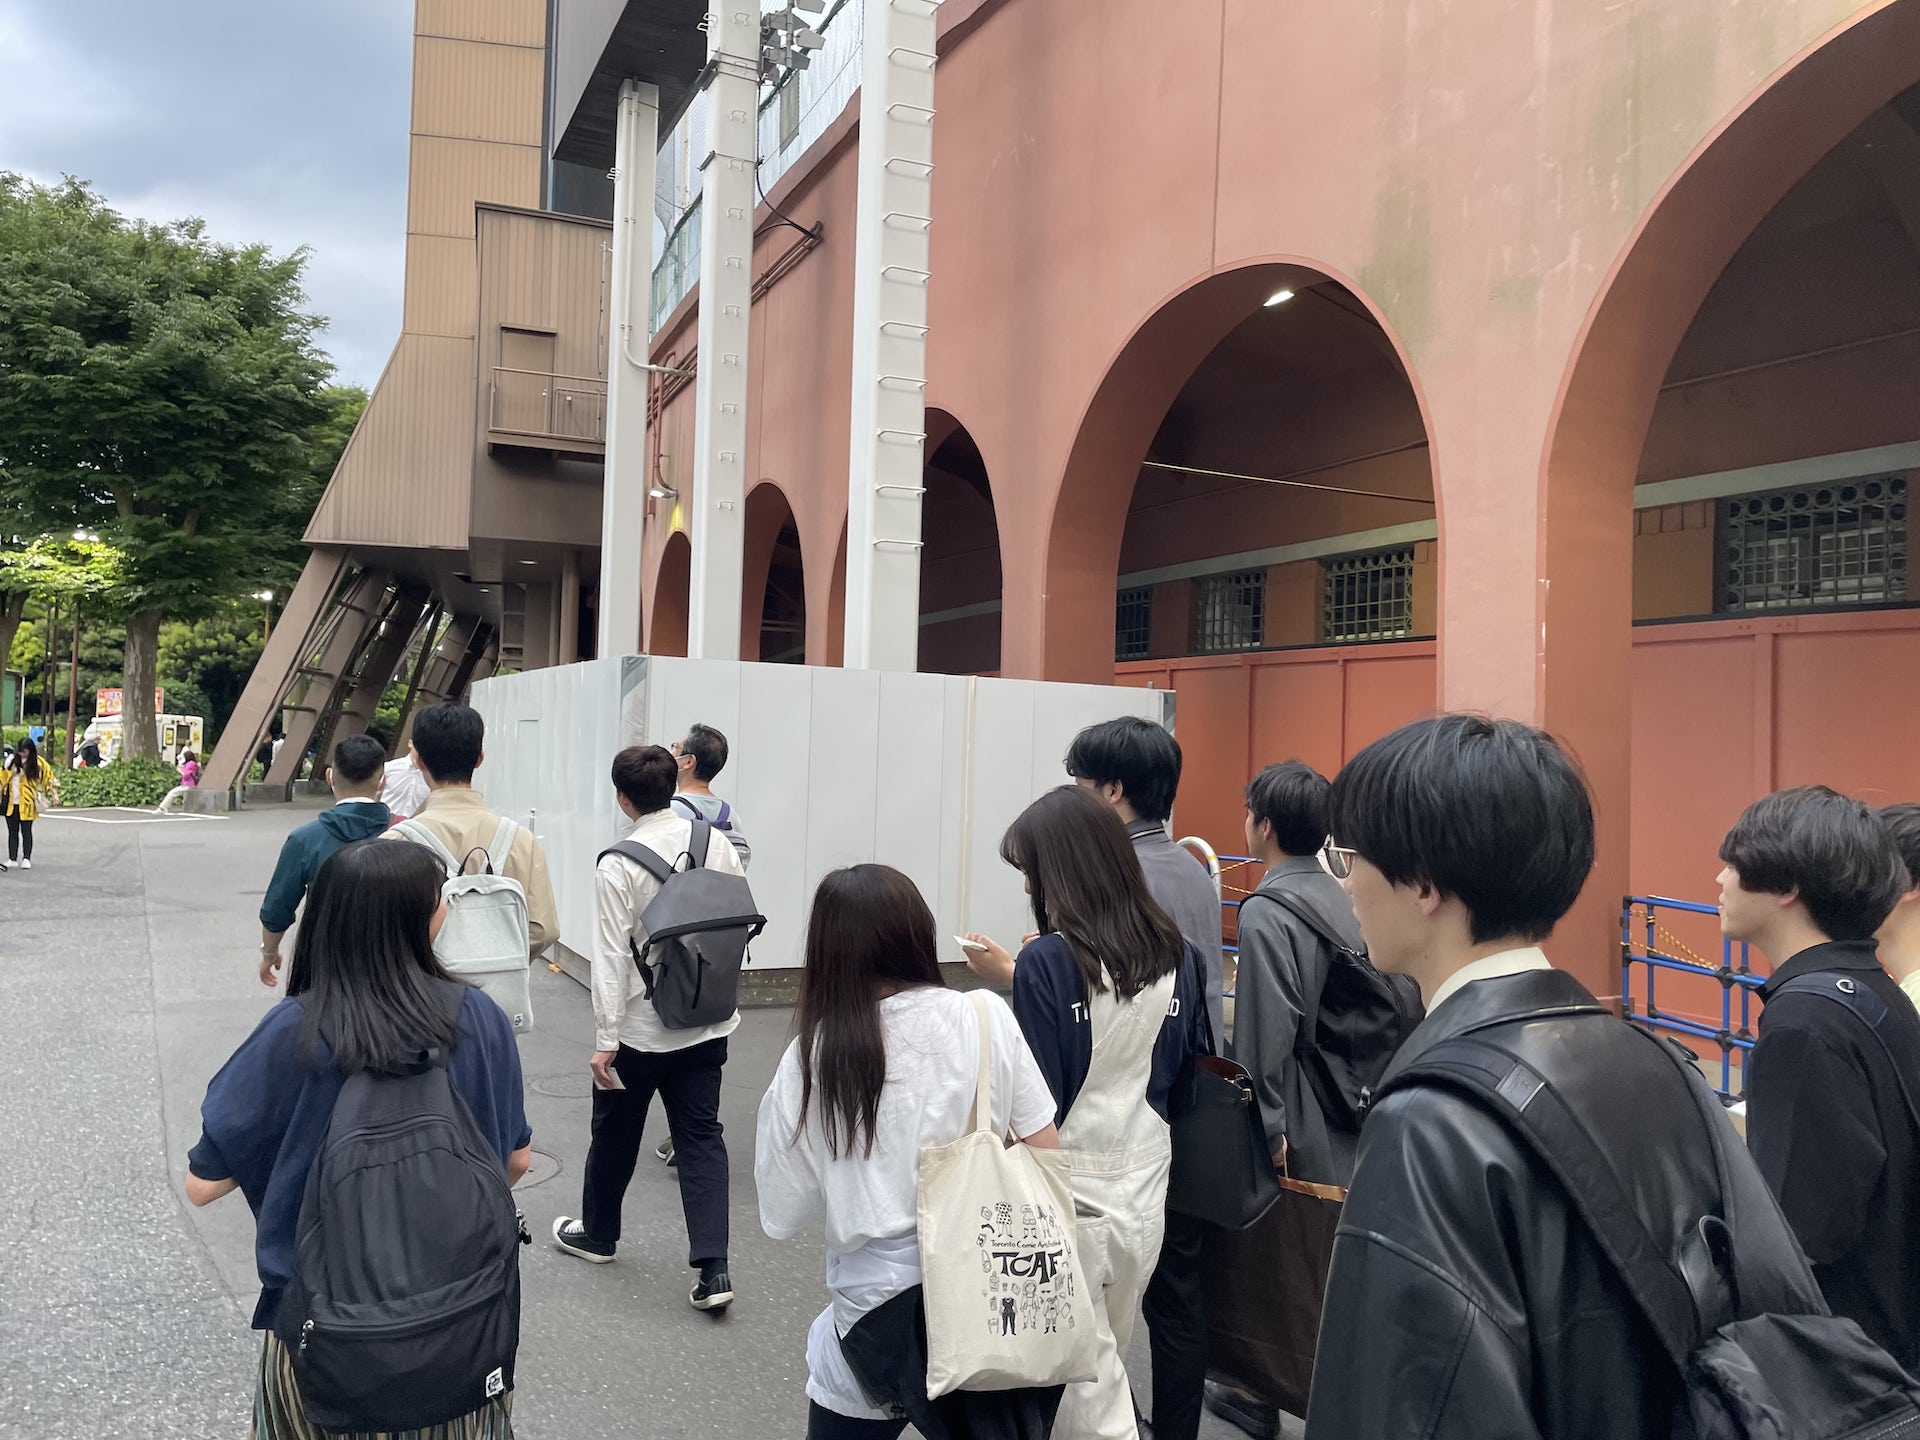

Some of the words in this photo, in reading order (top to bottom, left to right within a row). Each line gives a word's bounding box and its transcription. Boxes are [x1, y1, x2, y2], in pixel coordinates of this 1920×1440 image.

[991, 1239, 1016, 1248] Toronto
[1016, 1240, 1037, 1248] Comic
[992, 1248, 1063, 1285] TCAF
